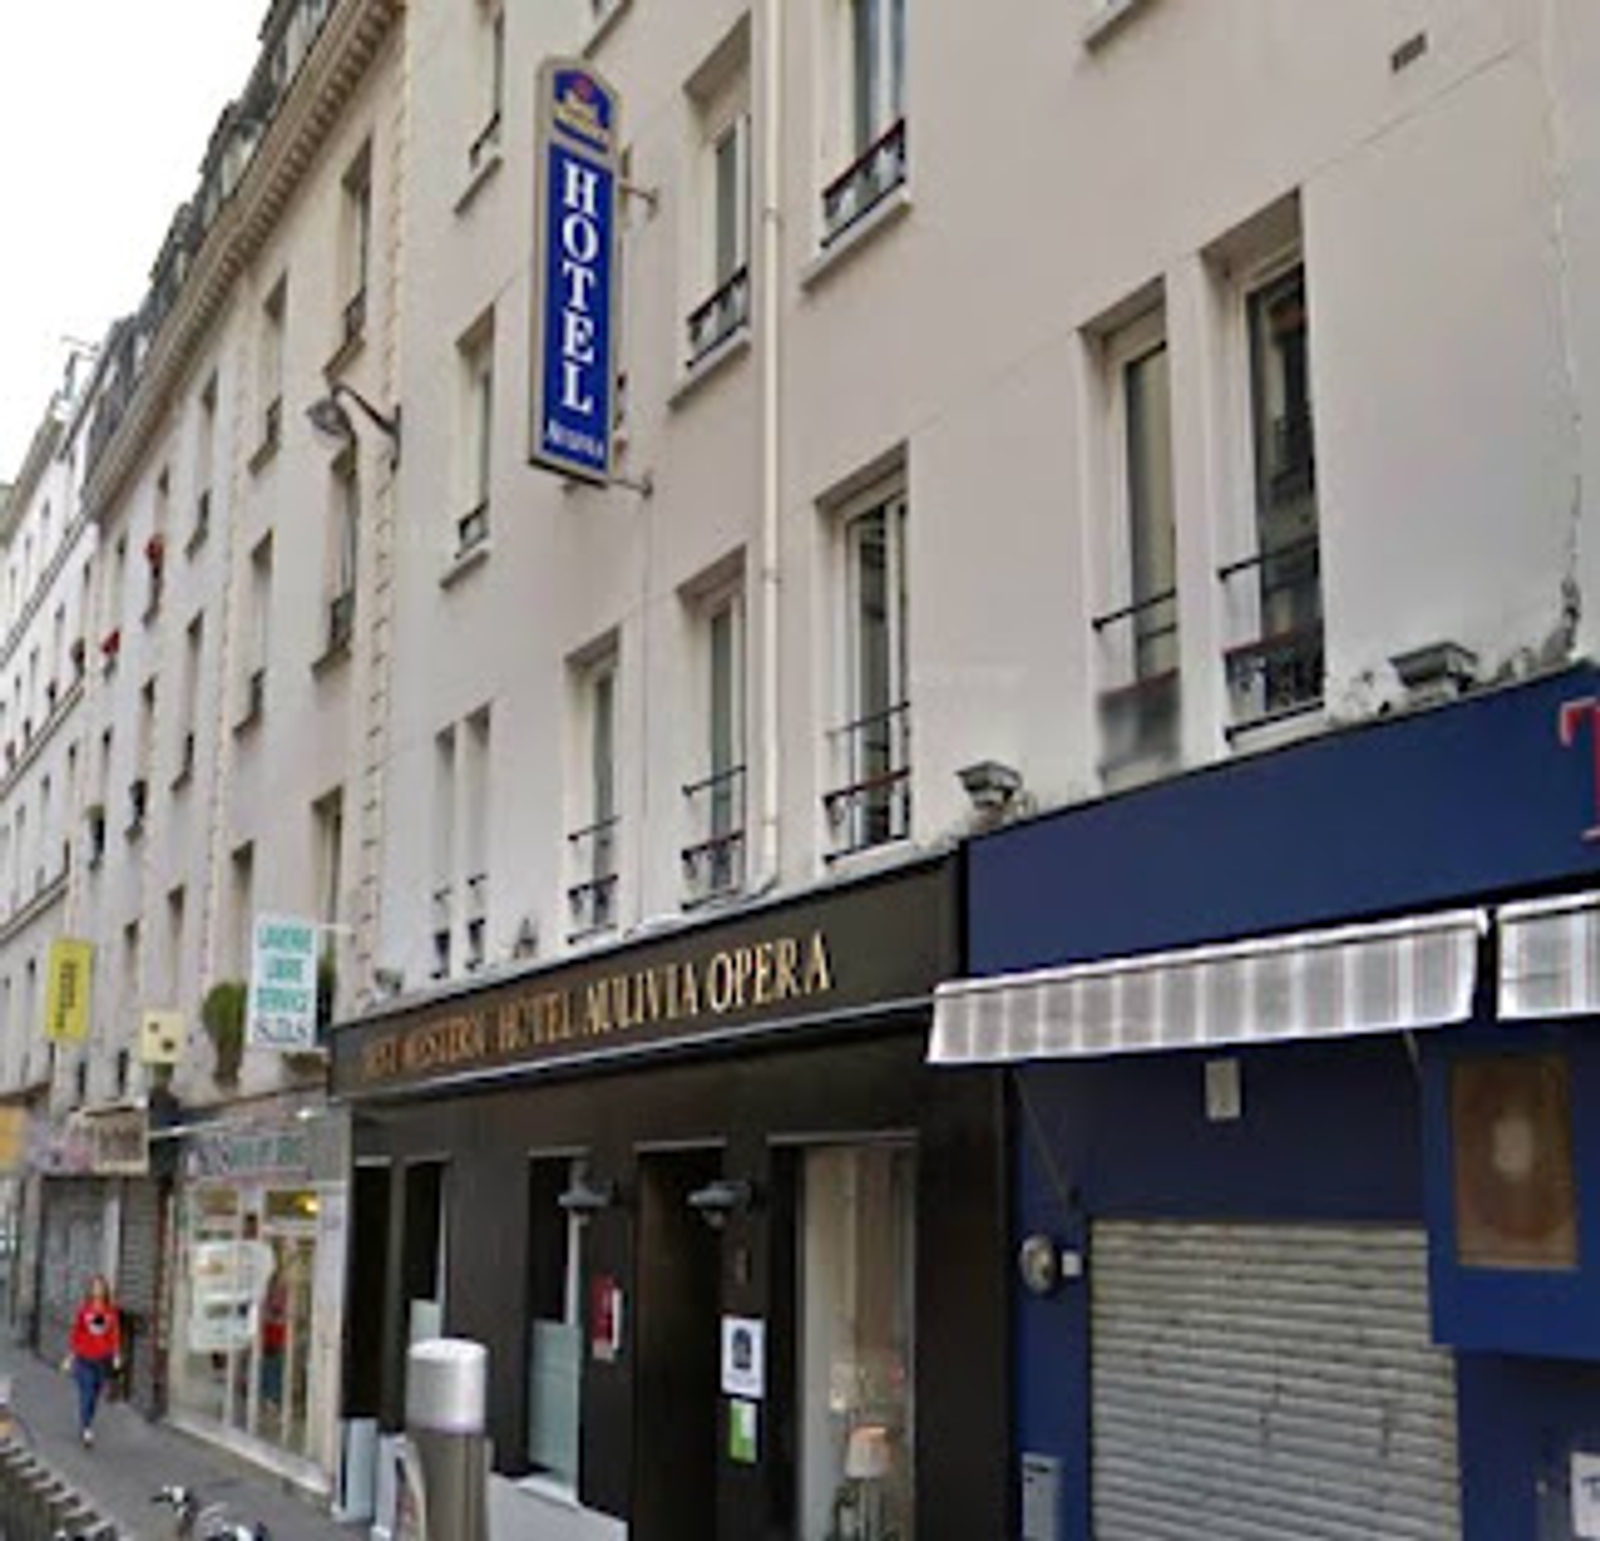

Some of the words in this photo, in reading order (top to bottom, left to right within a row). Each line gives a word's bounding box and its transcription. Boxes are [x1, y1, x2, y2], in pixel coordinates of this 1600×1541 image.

[561, 158, 598, 414] HOTEL
[499, 991, 573, 1048] HOTEL
[707, 929, 829, 1013] OPERA
